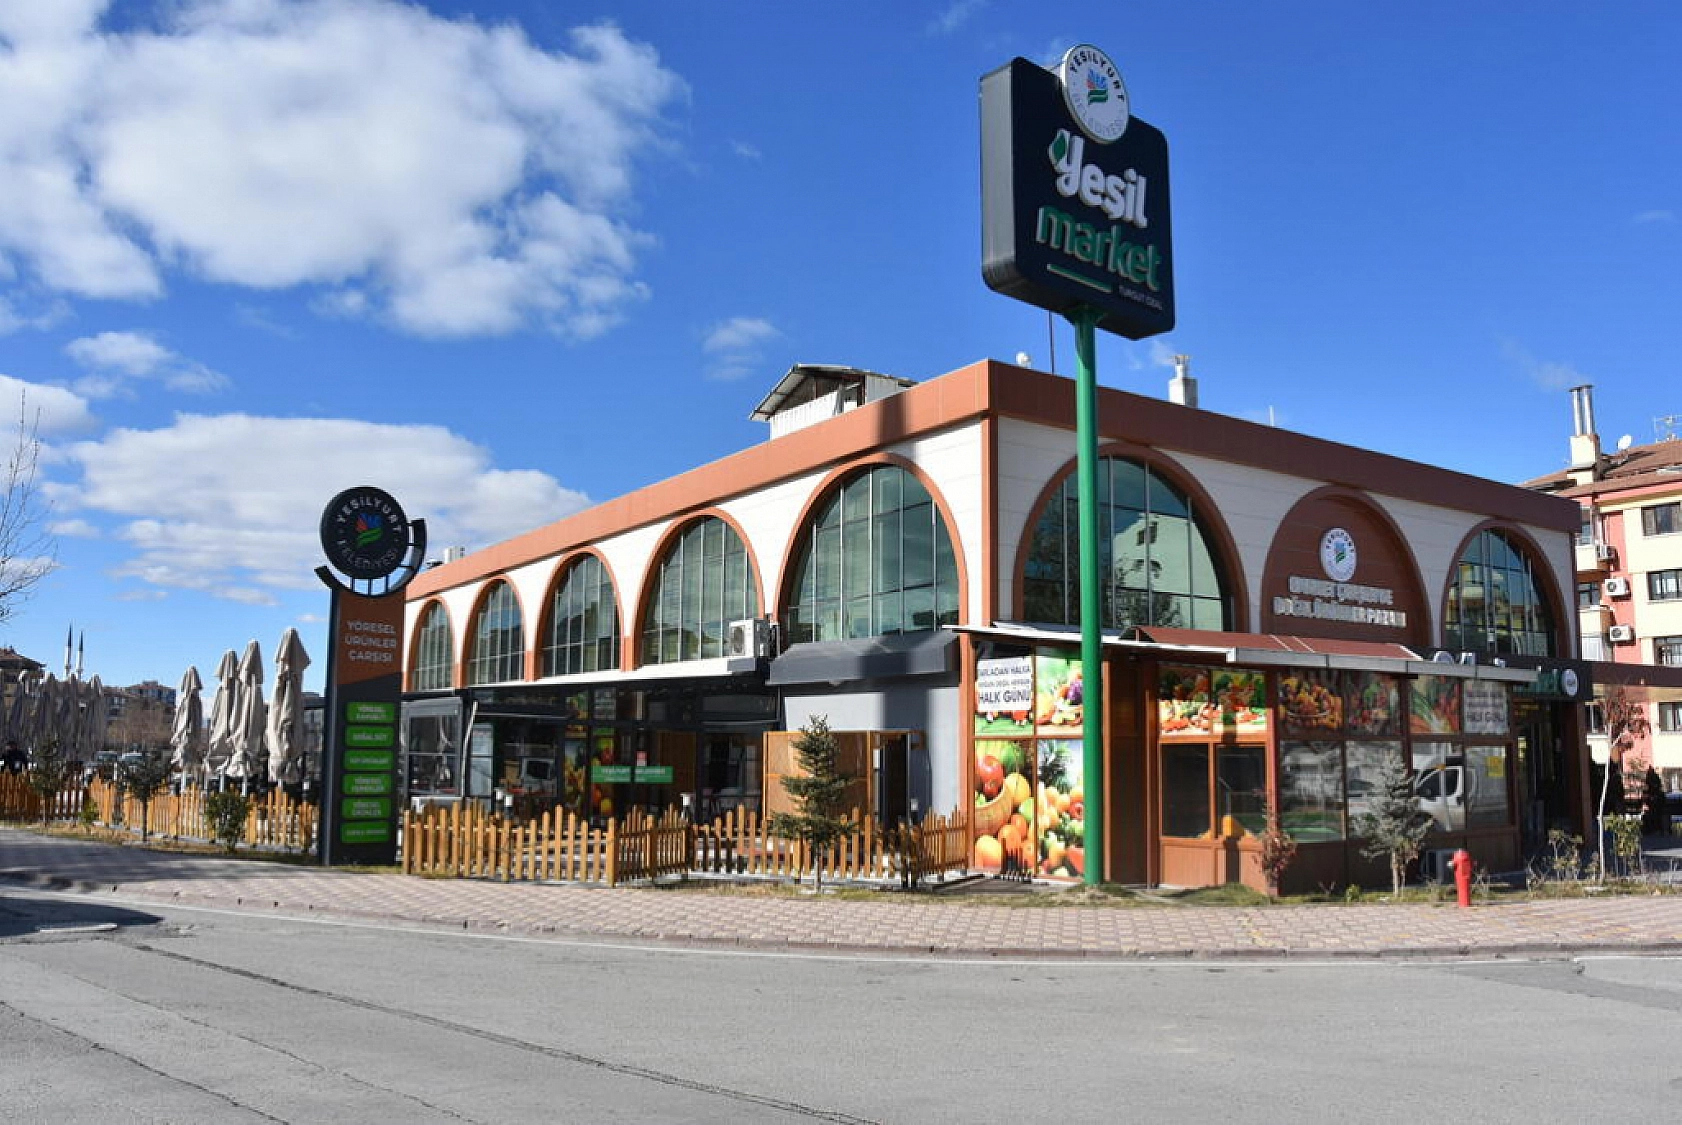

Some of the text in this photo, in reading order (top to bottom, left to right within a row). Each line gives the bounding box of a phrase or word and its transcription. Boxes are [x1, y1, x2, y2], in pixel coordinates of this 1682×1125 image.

[1036, 205, 1162, 291] market
[347, 619, 396, 634] YÖRESEL
[345, 633, 396, 648] ÜRÜNLER
[979, 691, 1000, 704] HALK
